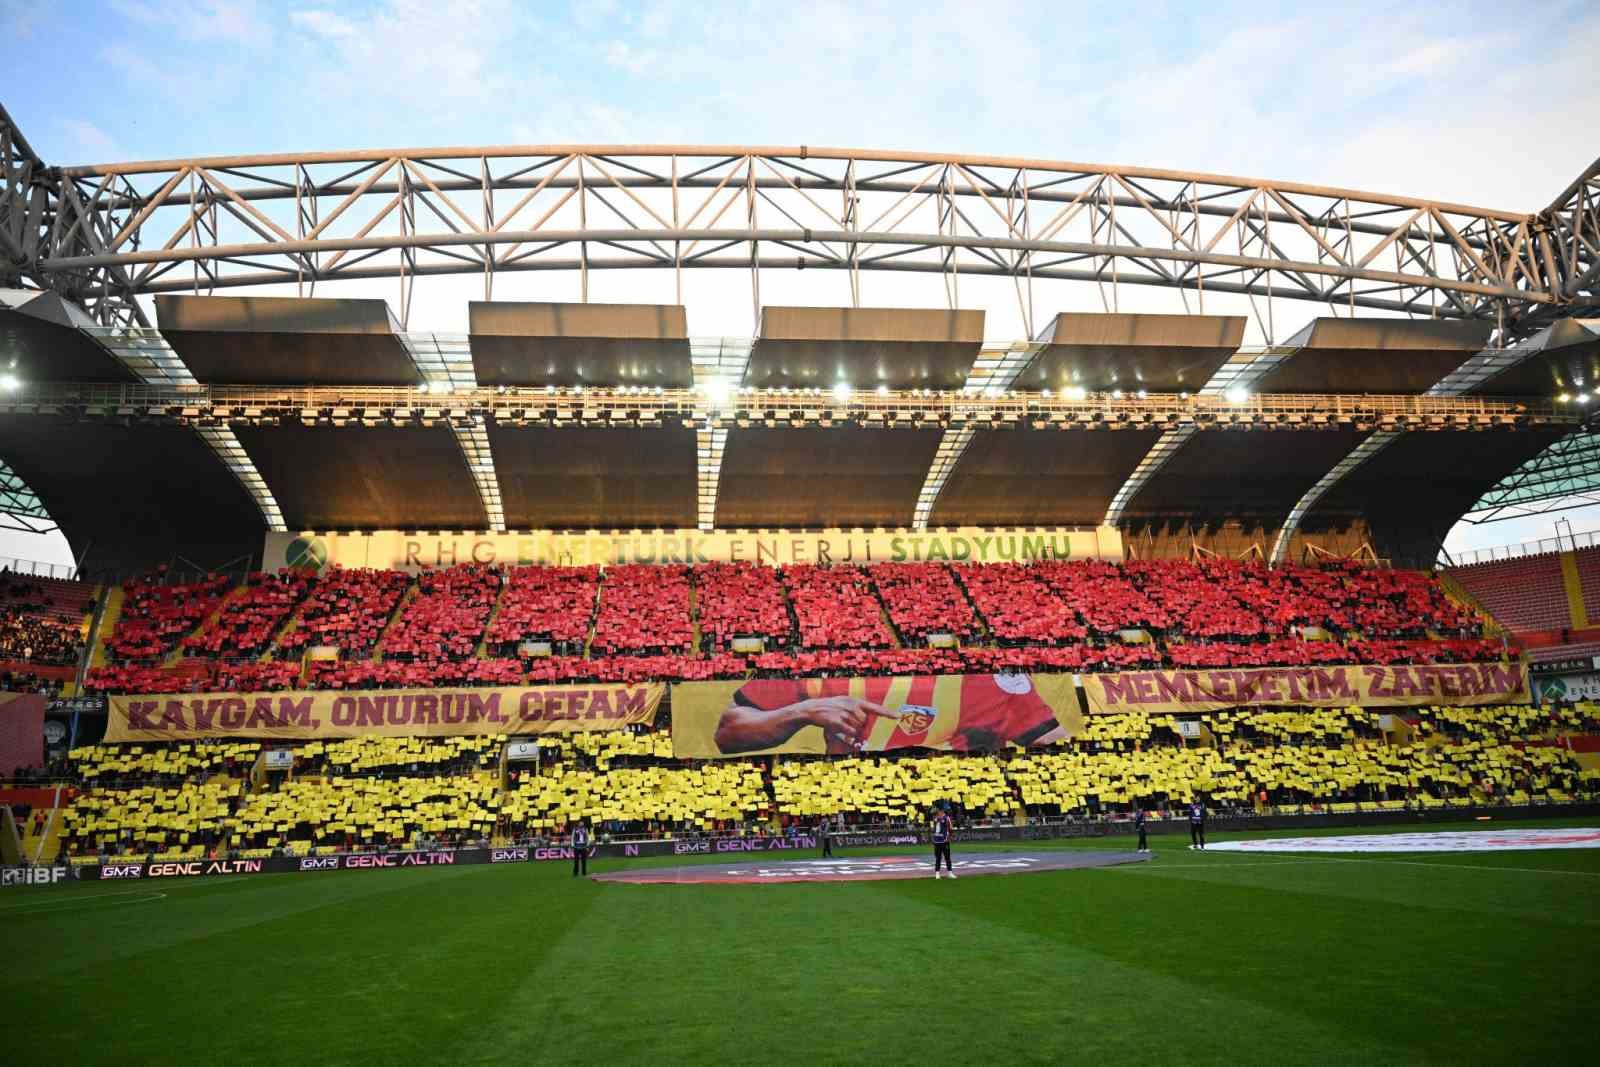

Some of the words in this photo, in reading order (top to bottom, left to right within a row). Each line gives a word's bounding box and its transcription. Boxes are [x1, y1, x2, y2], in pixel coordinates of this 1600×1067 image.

[405, 541, 497, 566] RHG
[890, 535, 1072, 561] STADYUMU
[127, 696, 321, 730] KAVGAM,
[330, 690, 510, 727] ONURUM,
[518, 688, 649, 721] CEFAM
[768, 836, 817, 849] ALTIN
[302, 859, 337, 870] GMR
[402, 851, 455, 866] ALTIN
[493, 851, 528, 861] GMR
[535, 848, 575, 860] GEN
[102, 866, 141, 878] GMR
[206, 860, 262, 875] ALTIN
